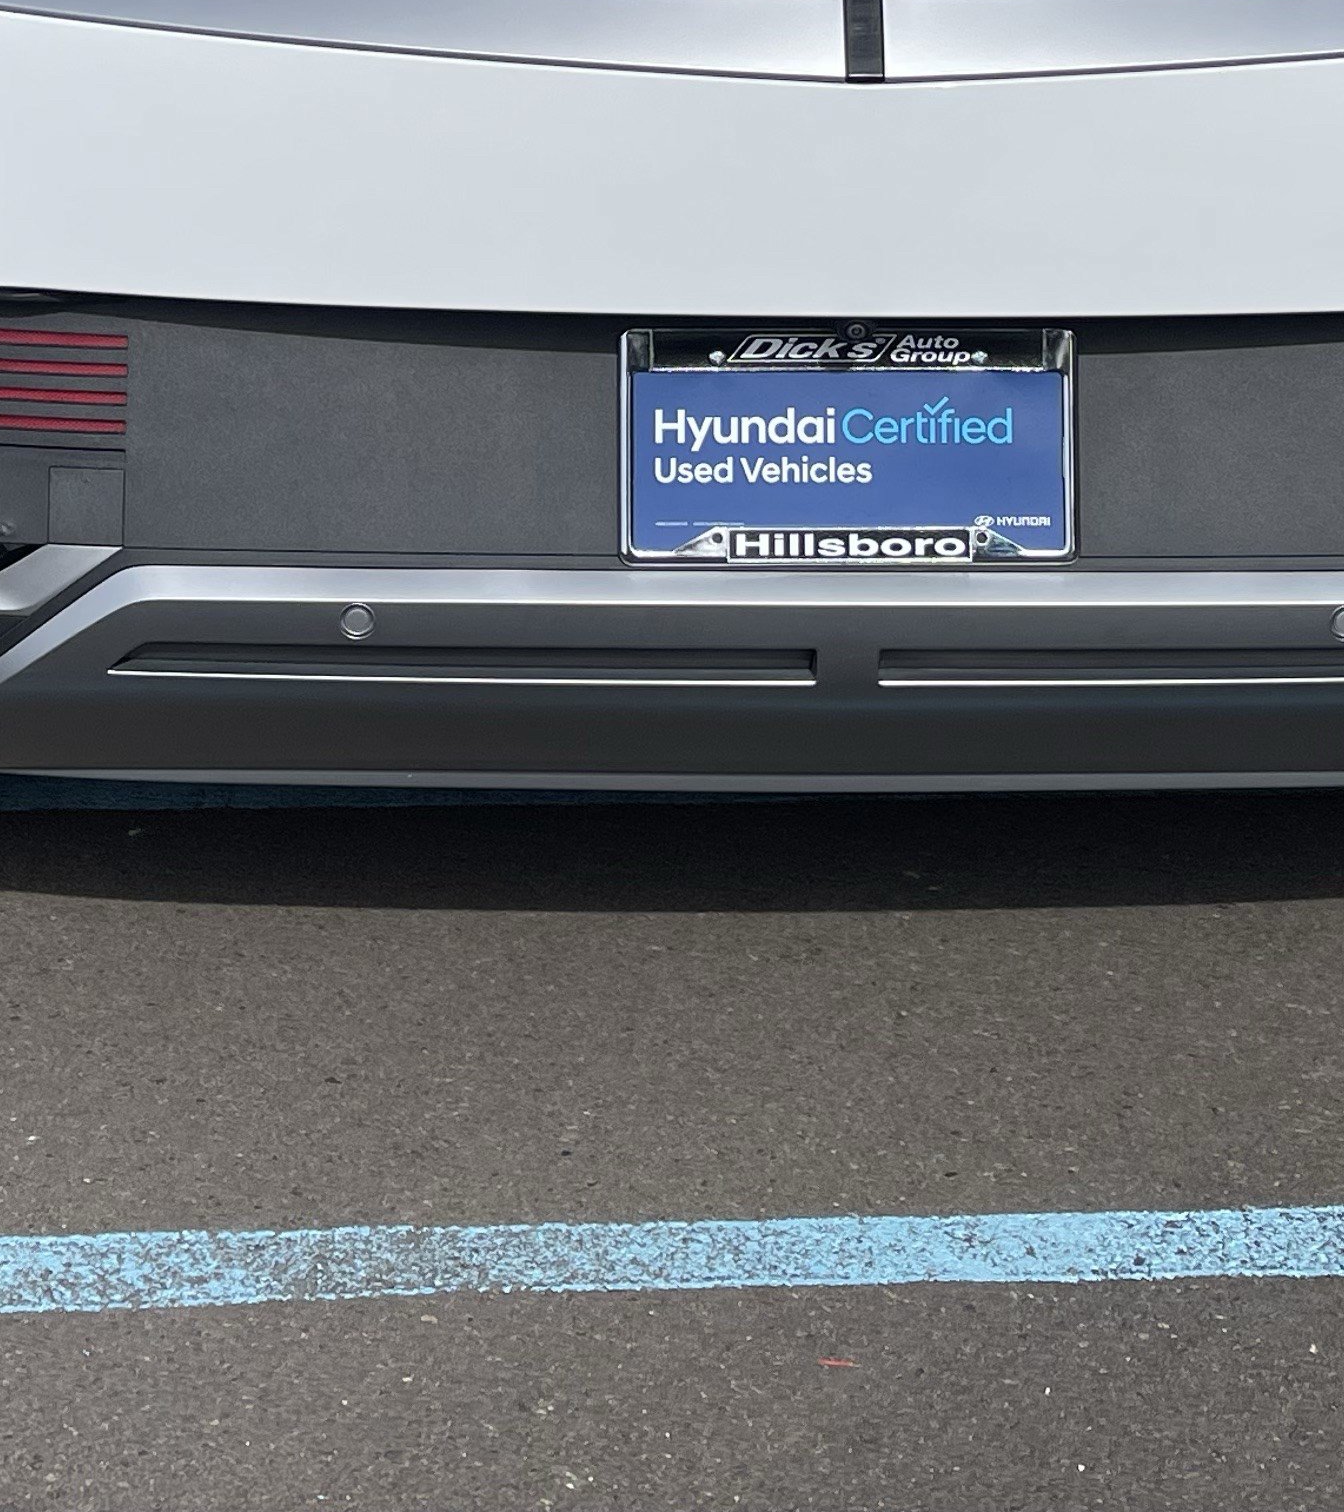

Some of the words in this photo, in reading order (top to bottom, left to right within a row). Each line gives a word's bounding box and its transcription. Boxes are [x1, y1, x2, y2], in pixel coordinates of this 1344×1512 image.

[740, 337, 878, 359] Dicks
[896, 335, 959, 349] Auto
[890, 349, 970, 365] Group
[654, 407, 836, 452] Hyundai
[842, 396, 1013, 445] Certified
[655, 456, 734, 483] Used
[740, 456, 872, 484] Vehicles
[996, 516, 1051, 526] HYUNDAI
[735, 533, 966, 558] Hillsboro
